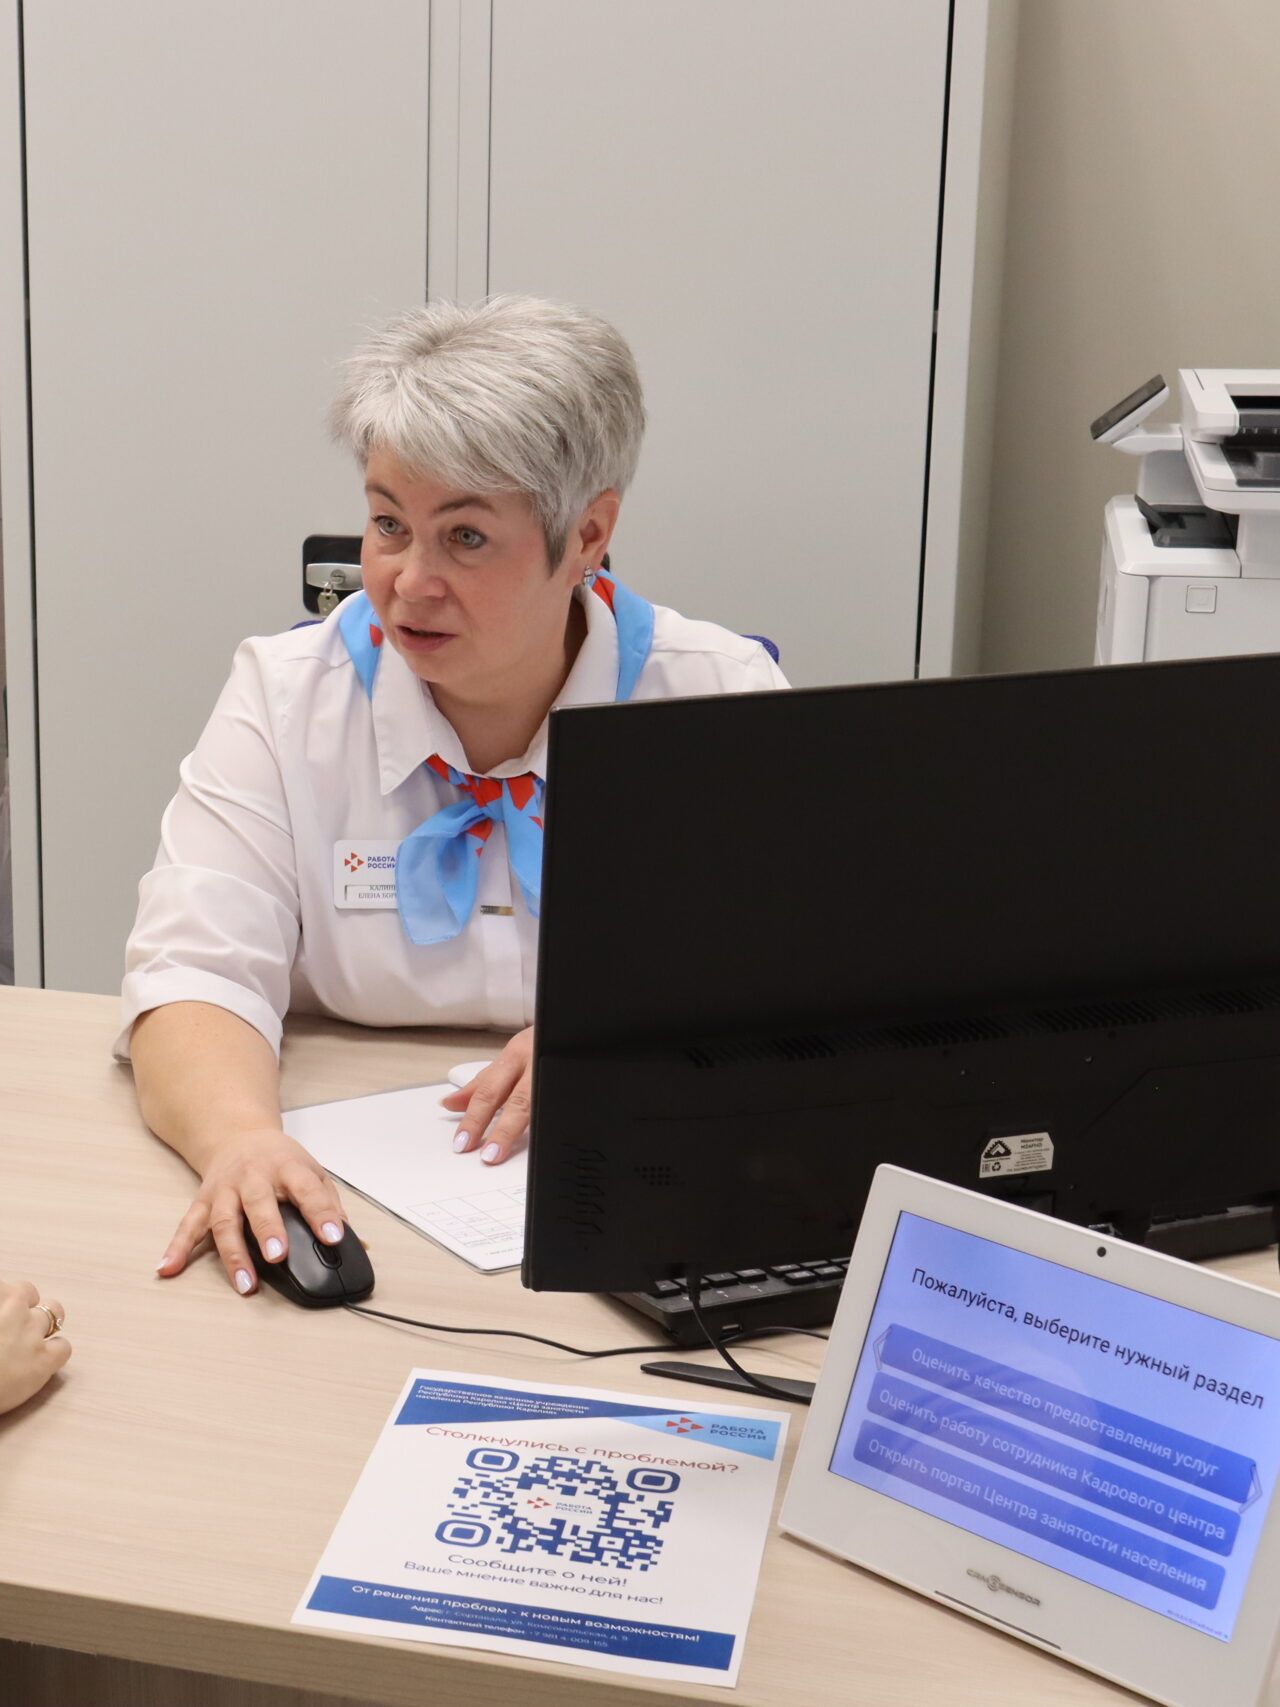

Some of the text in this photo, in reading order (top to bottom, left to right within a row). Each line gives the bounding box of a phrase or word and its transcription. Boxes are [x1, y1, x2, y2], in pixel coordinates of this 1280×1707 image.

[911, 1267, 1265, 1410] Пожалуйста, выберите нужный раздел
[417, 1389, 469, 1400] Республики
[470, 1396, 507, 1405] Карелия
[462, 1399, 515, 1411] Республики
[911, 1347, 1219, 1477] Оценить качество предоставления услуг
[709, 1429, 767, 1441] РОССИИ
[710, 1423, 765, 1435] РАБОТА
[425, 1426, 740, 1474] Столкнулись с проблемой?
[879, 1389, 1227, 1541] Оценить работу сотрудника Кадрового центра
[555, 1506, 593, 1515] РОССИИ
[556, 1501, 592, 1511] РАБОТА
[868, 1438, 1208, 1592] Открыть портал Центра занятости населения
[403, 1560, 664, 1605] Ваше мнение важно для нас!
[447, 1552, 628, 1588] Сообщите о ней!
[351, 1585, 371, 1595] От
[372, 1588, 440, 1604] решения
[442, 1598, 508, 1615] проблем
[532, 1613, 582, 1625] новым
[585, 1620, 701, 1643] возможностям!
[424, 1615, 483, 1629] Контактный
